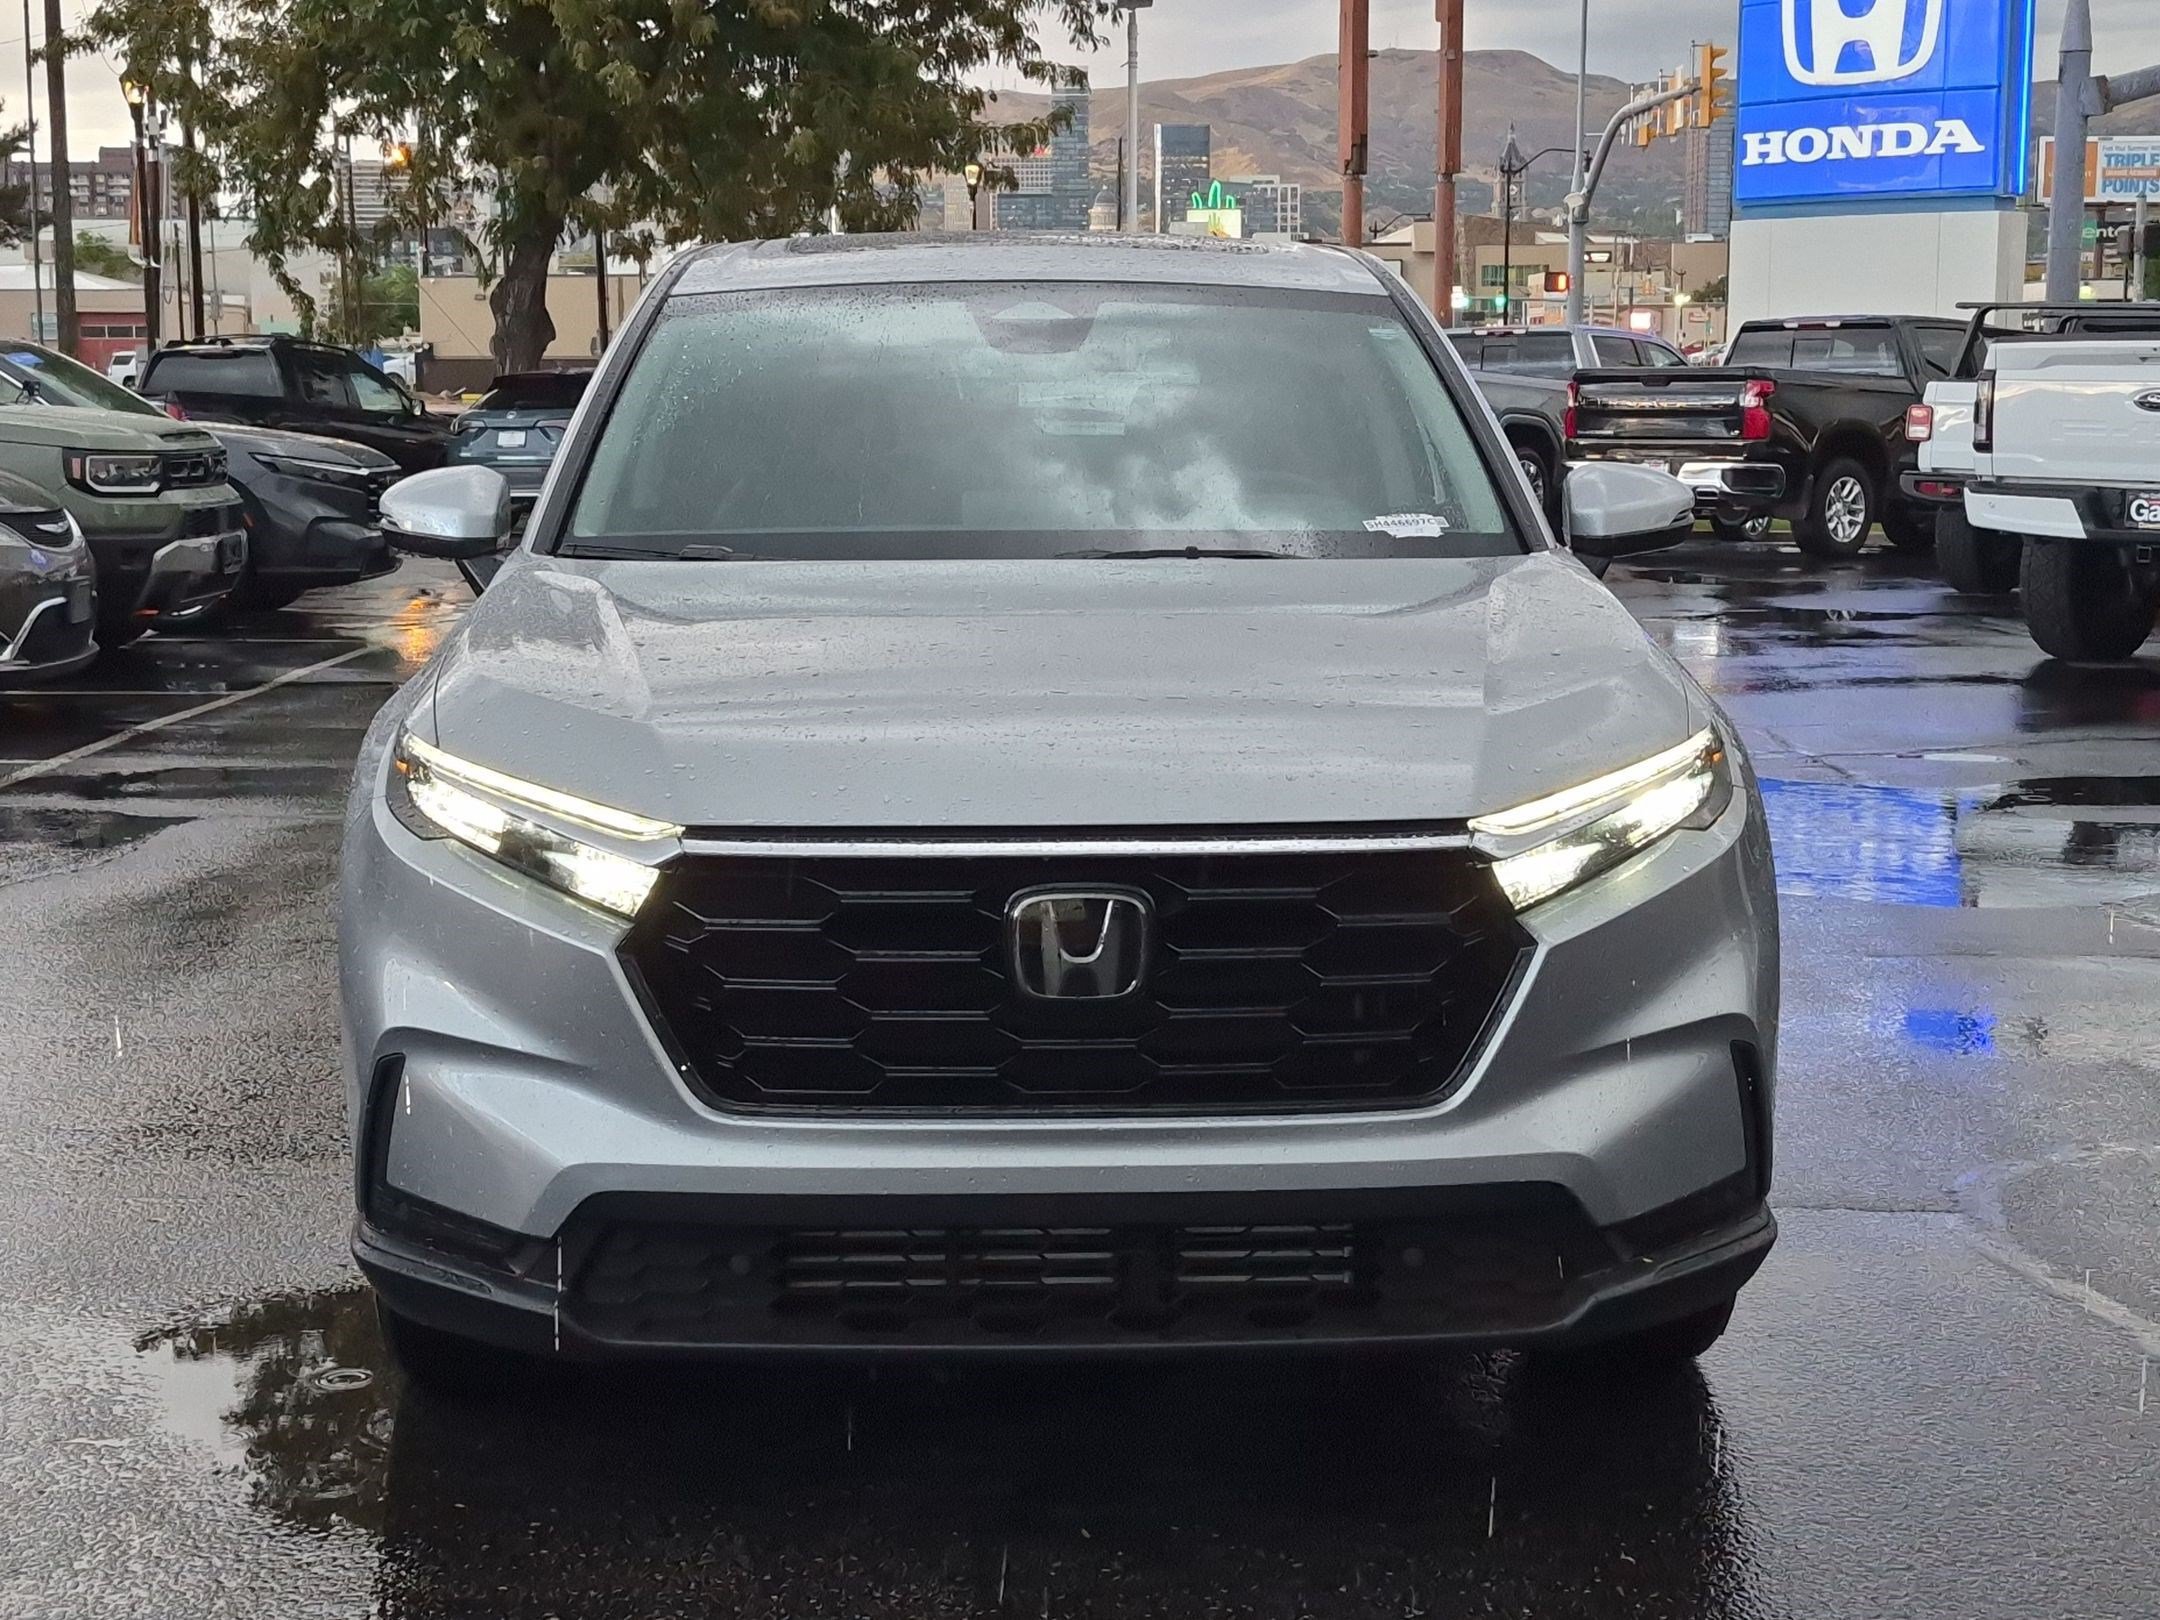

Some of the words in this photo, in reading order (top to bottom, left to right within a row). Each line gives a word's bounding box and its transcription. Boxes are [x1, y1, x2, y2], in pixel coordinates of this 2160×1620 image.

[1742, 119, 1985, 166] HONDA
[2103, 152, 2160, 168] TRIPLE
[2101, 178, 2160, 194] POINTS
